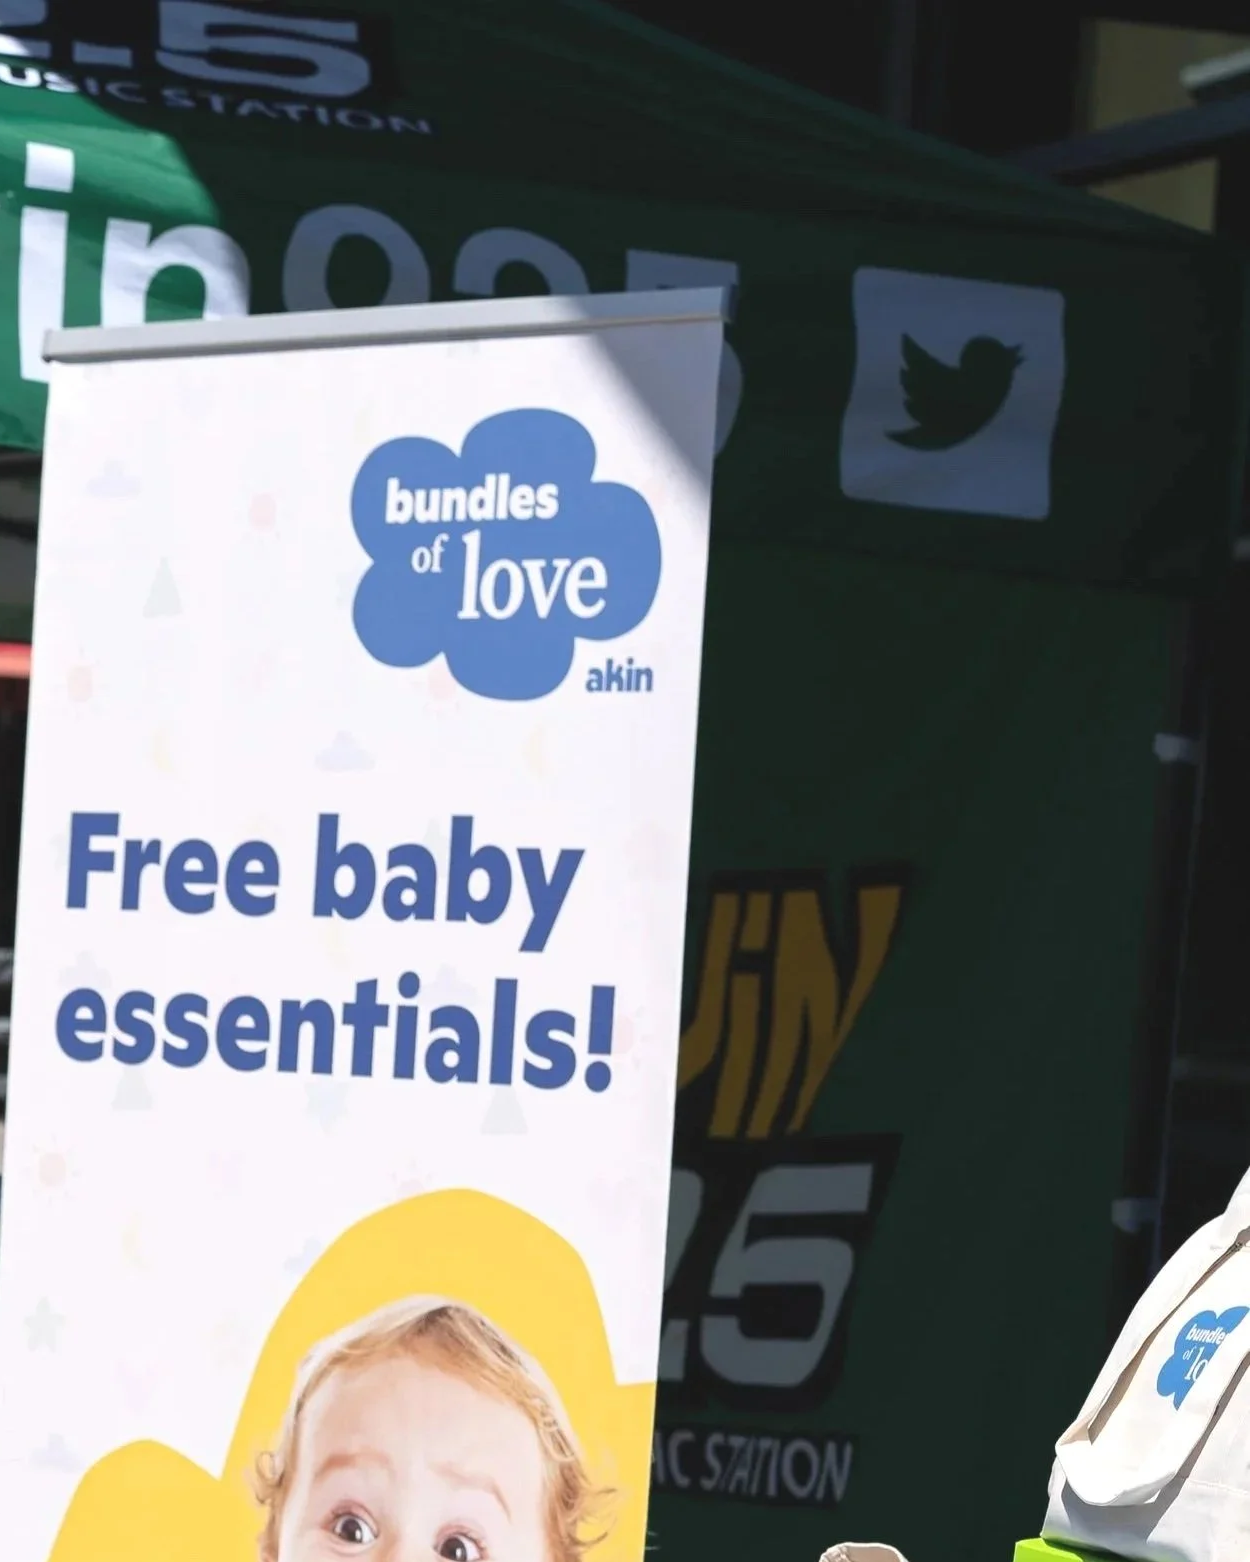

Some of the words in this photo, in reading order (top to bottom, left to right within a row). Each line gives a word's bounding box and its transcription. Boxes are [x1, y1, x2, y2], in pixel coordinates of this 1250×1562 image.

[162, 85, 435, 135] STATION
[385, 473, 559, 524] bundles
[411, 533, 450, 574] of
[456, 529, 608, 620] love
[584, 657, 653, 694] akin
[65, 811, 281, 917] Free
[312, 812, 586, 953] baby
[55, 970, 617, 1093] essentials!
[700, 1431, 854, 1503] STATION
